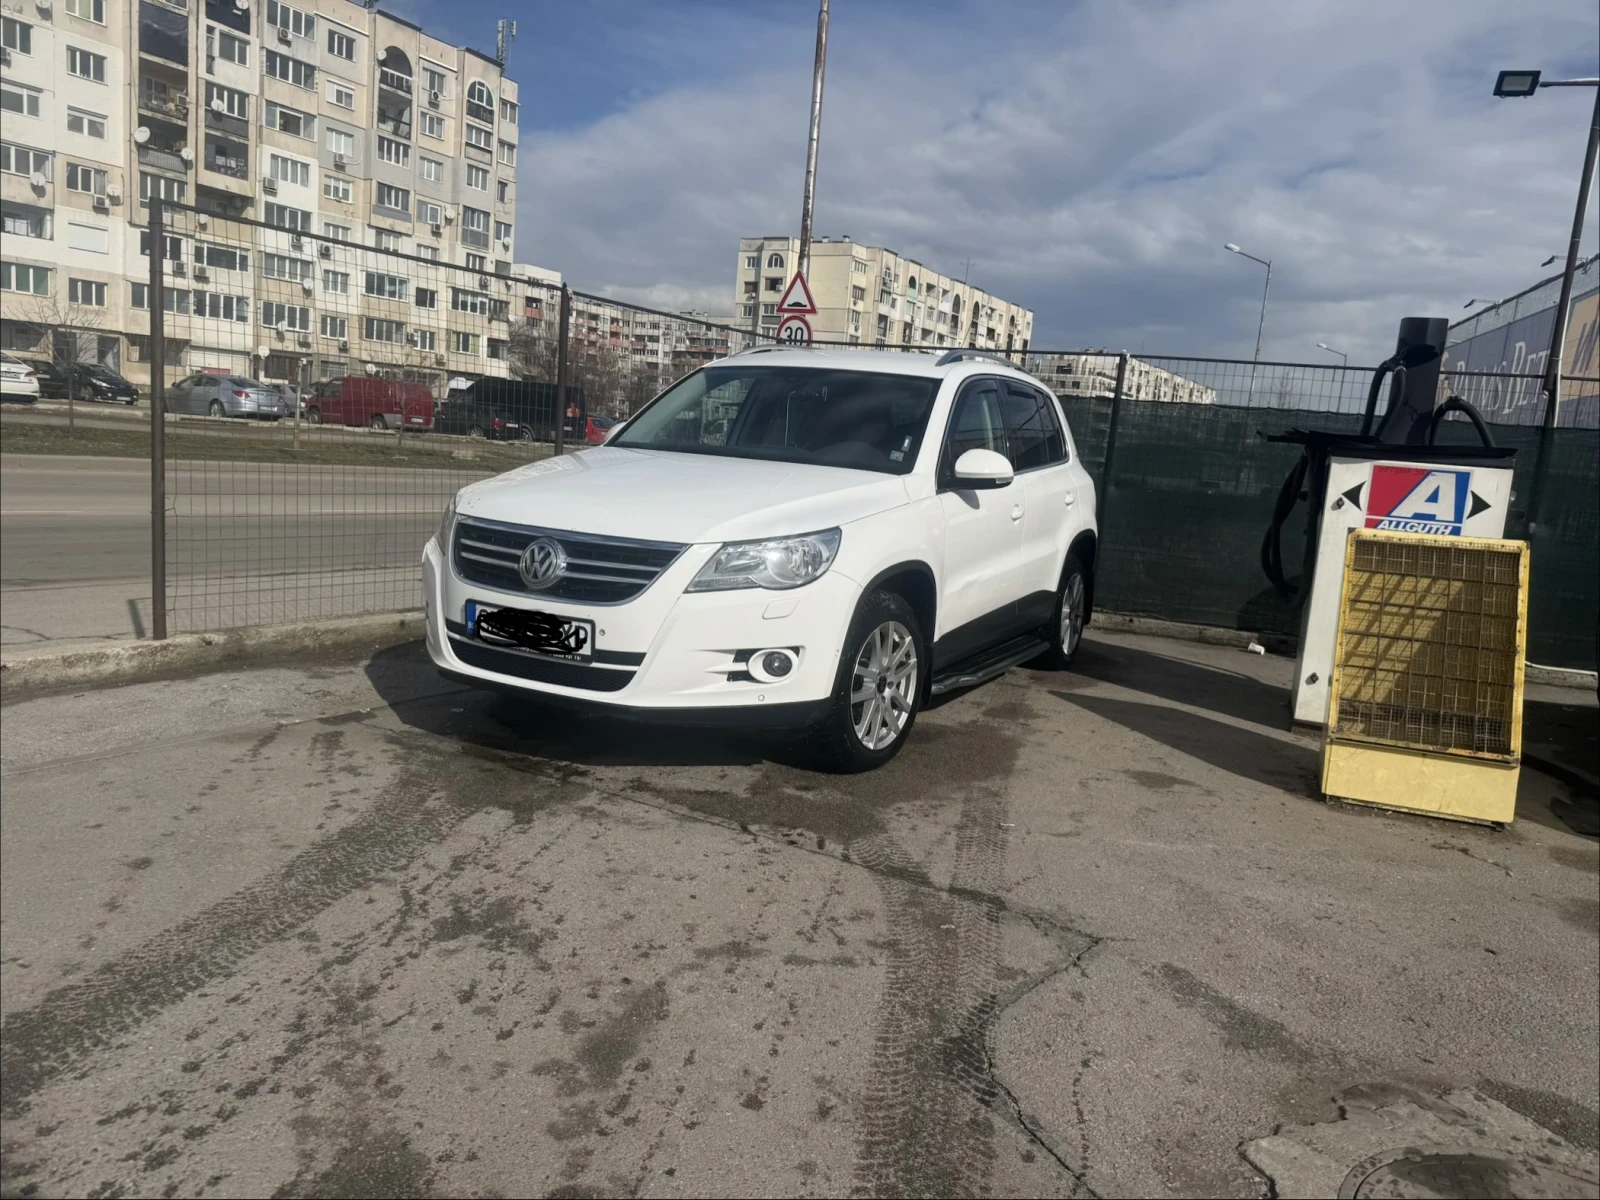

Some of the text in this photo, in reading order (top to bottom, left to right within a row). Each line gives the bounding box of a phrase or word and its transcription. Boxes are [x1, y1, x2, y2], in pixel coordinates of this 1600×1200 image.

[784, 326, 804, 346] 30
[1389, 471, 1457, 522] A
[1377, 520, 1453, 536] ALLGUTH
